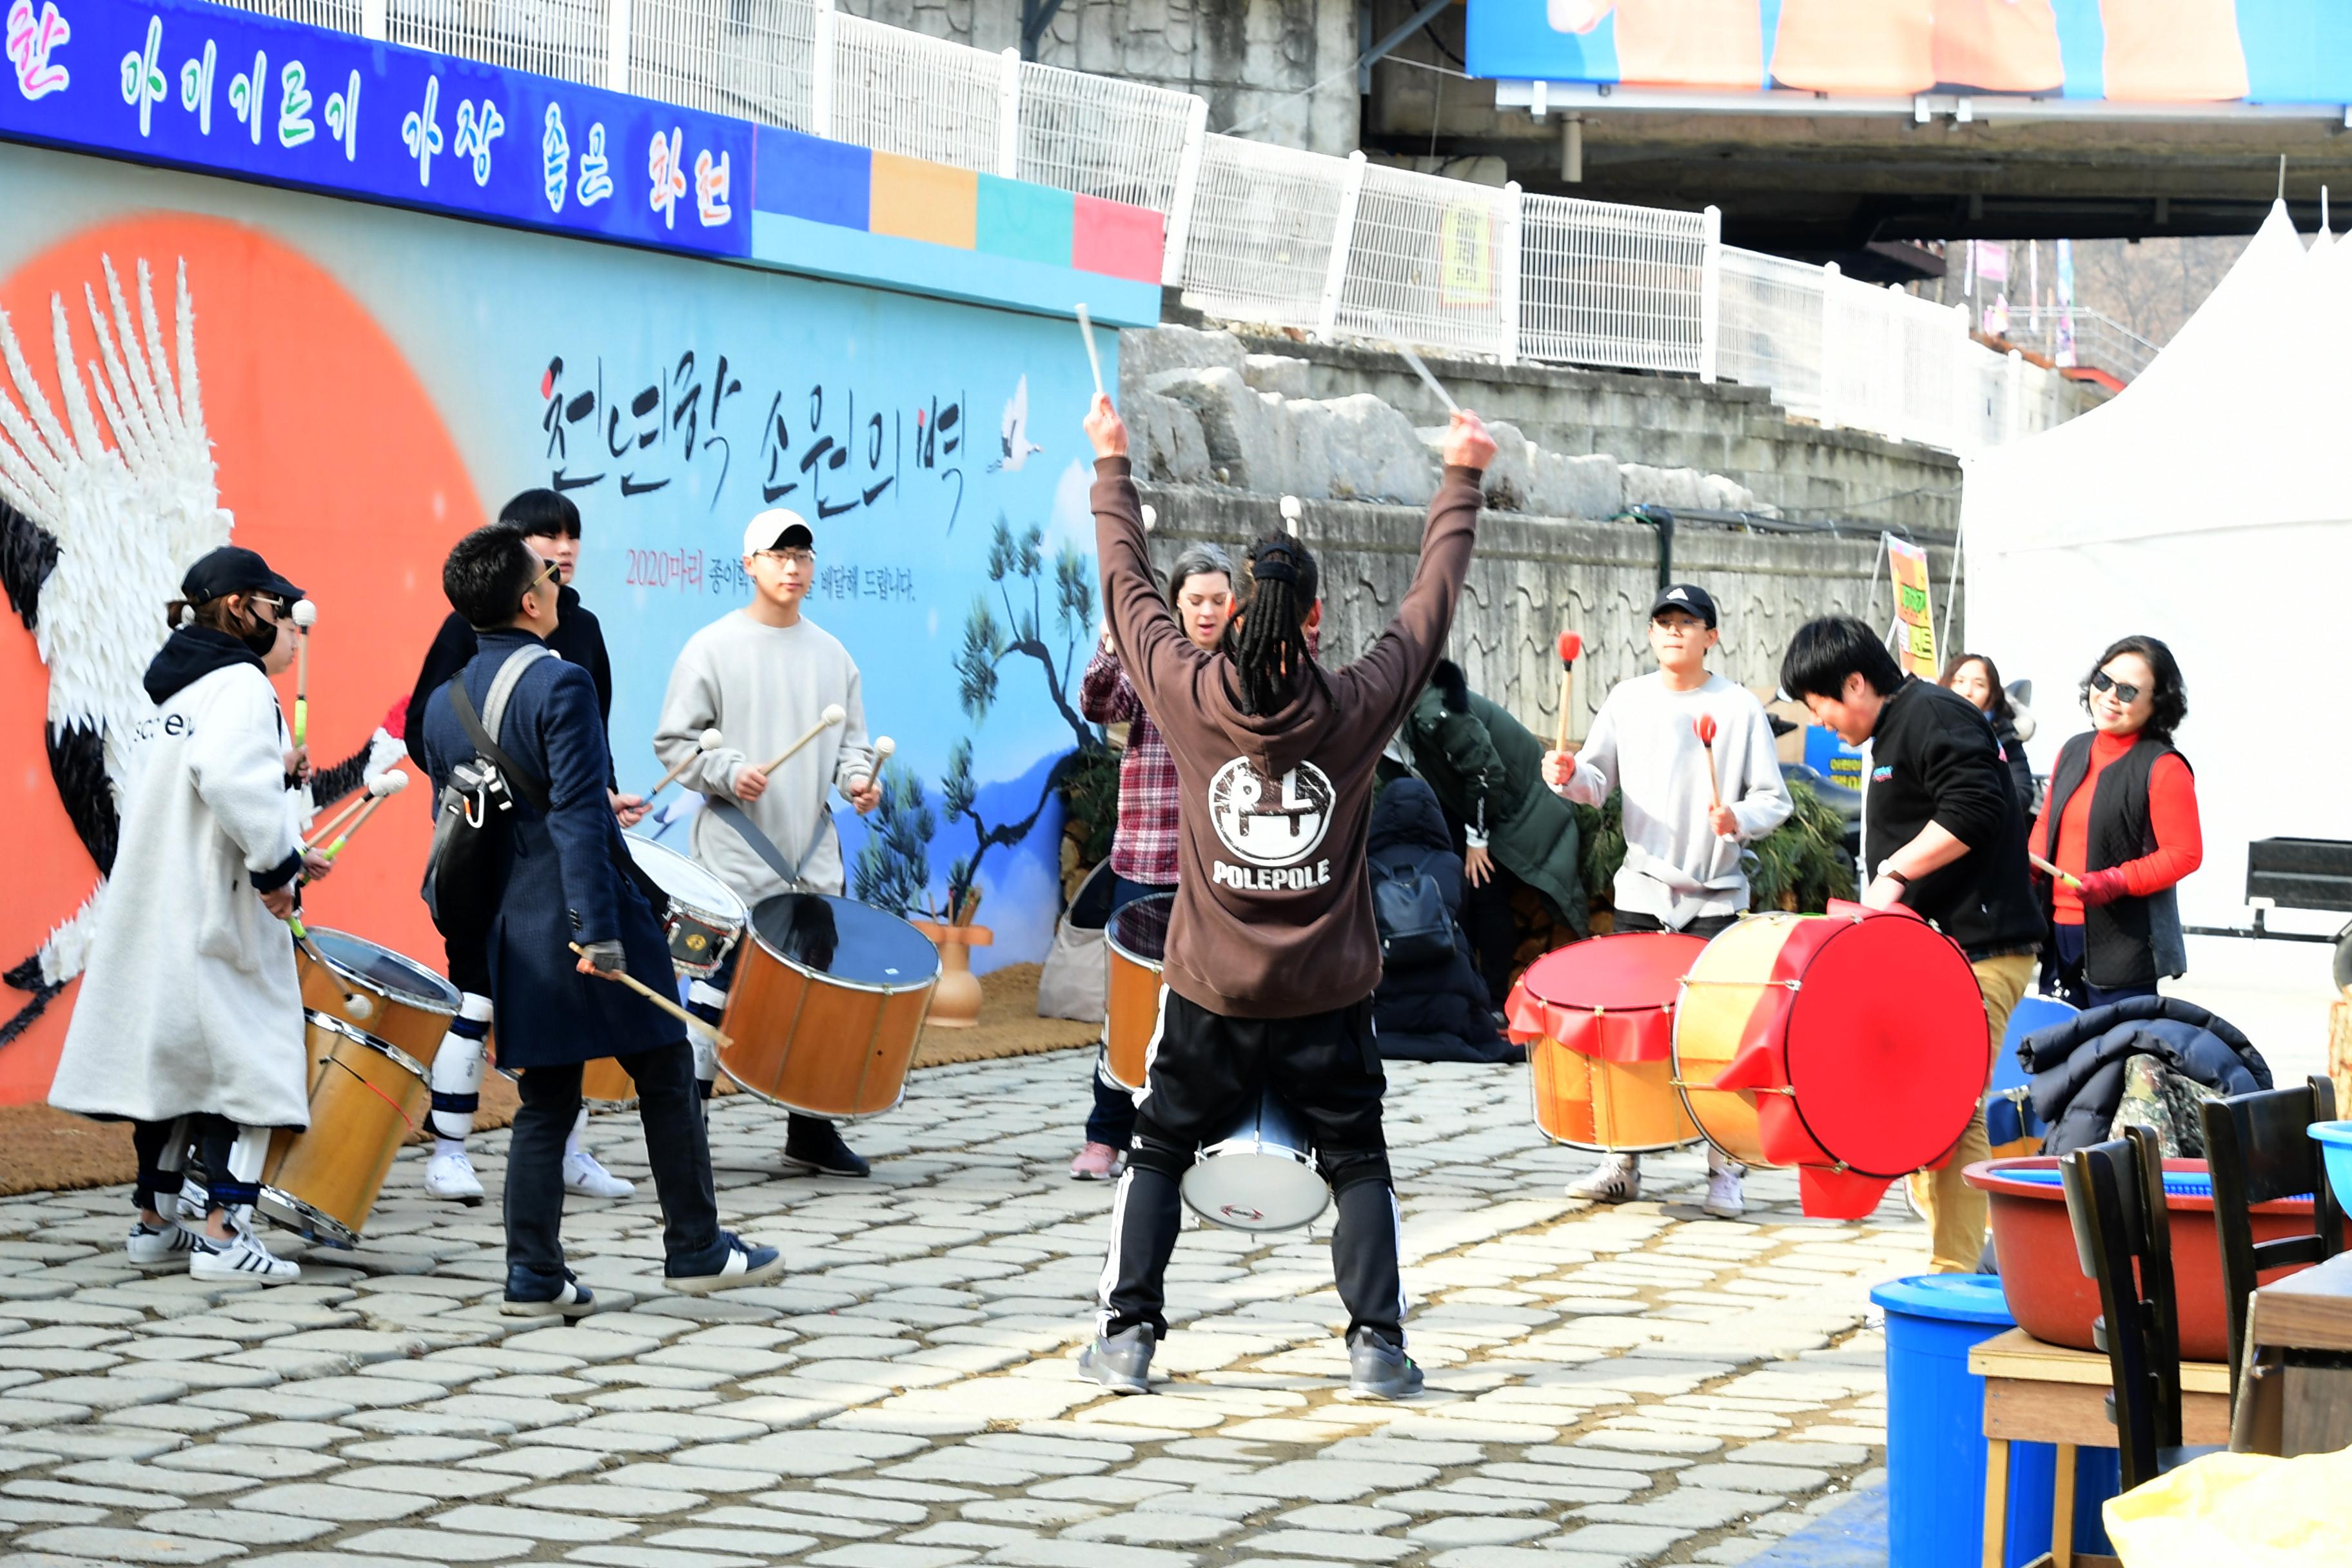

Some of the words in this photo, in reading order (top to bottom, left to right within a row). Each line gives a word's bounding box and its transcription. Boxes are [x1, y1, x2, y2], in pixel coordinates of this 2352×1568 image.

[402, 74, 505, 187] 가장
[542, 101, 614, 213] 좋은
[649, 126, 732, 230] 화천
[541, 349, 741, 512] 천년학
[626, 548, 703, 595] 2020마리
[1213, 859, 1331, 891] POLEPOLE
